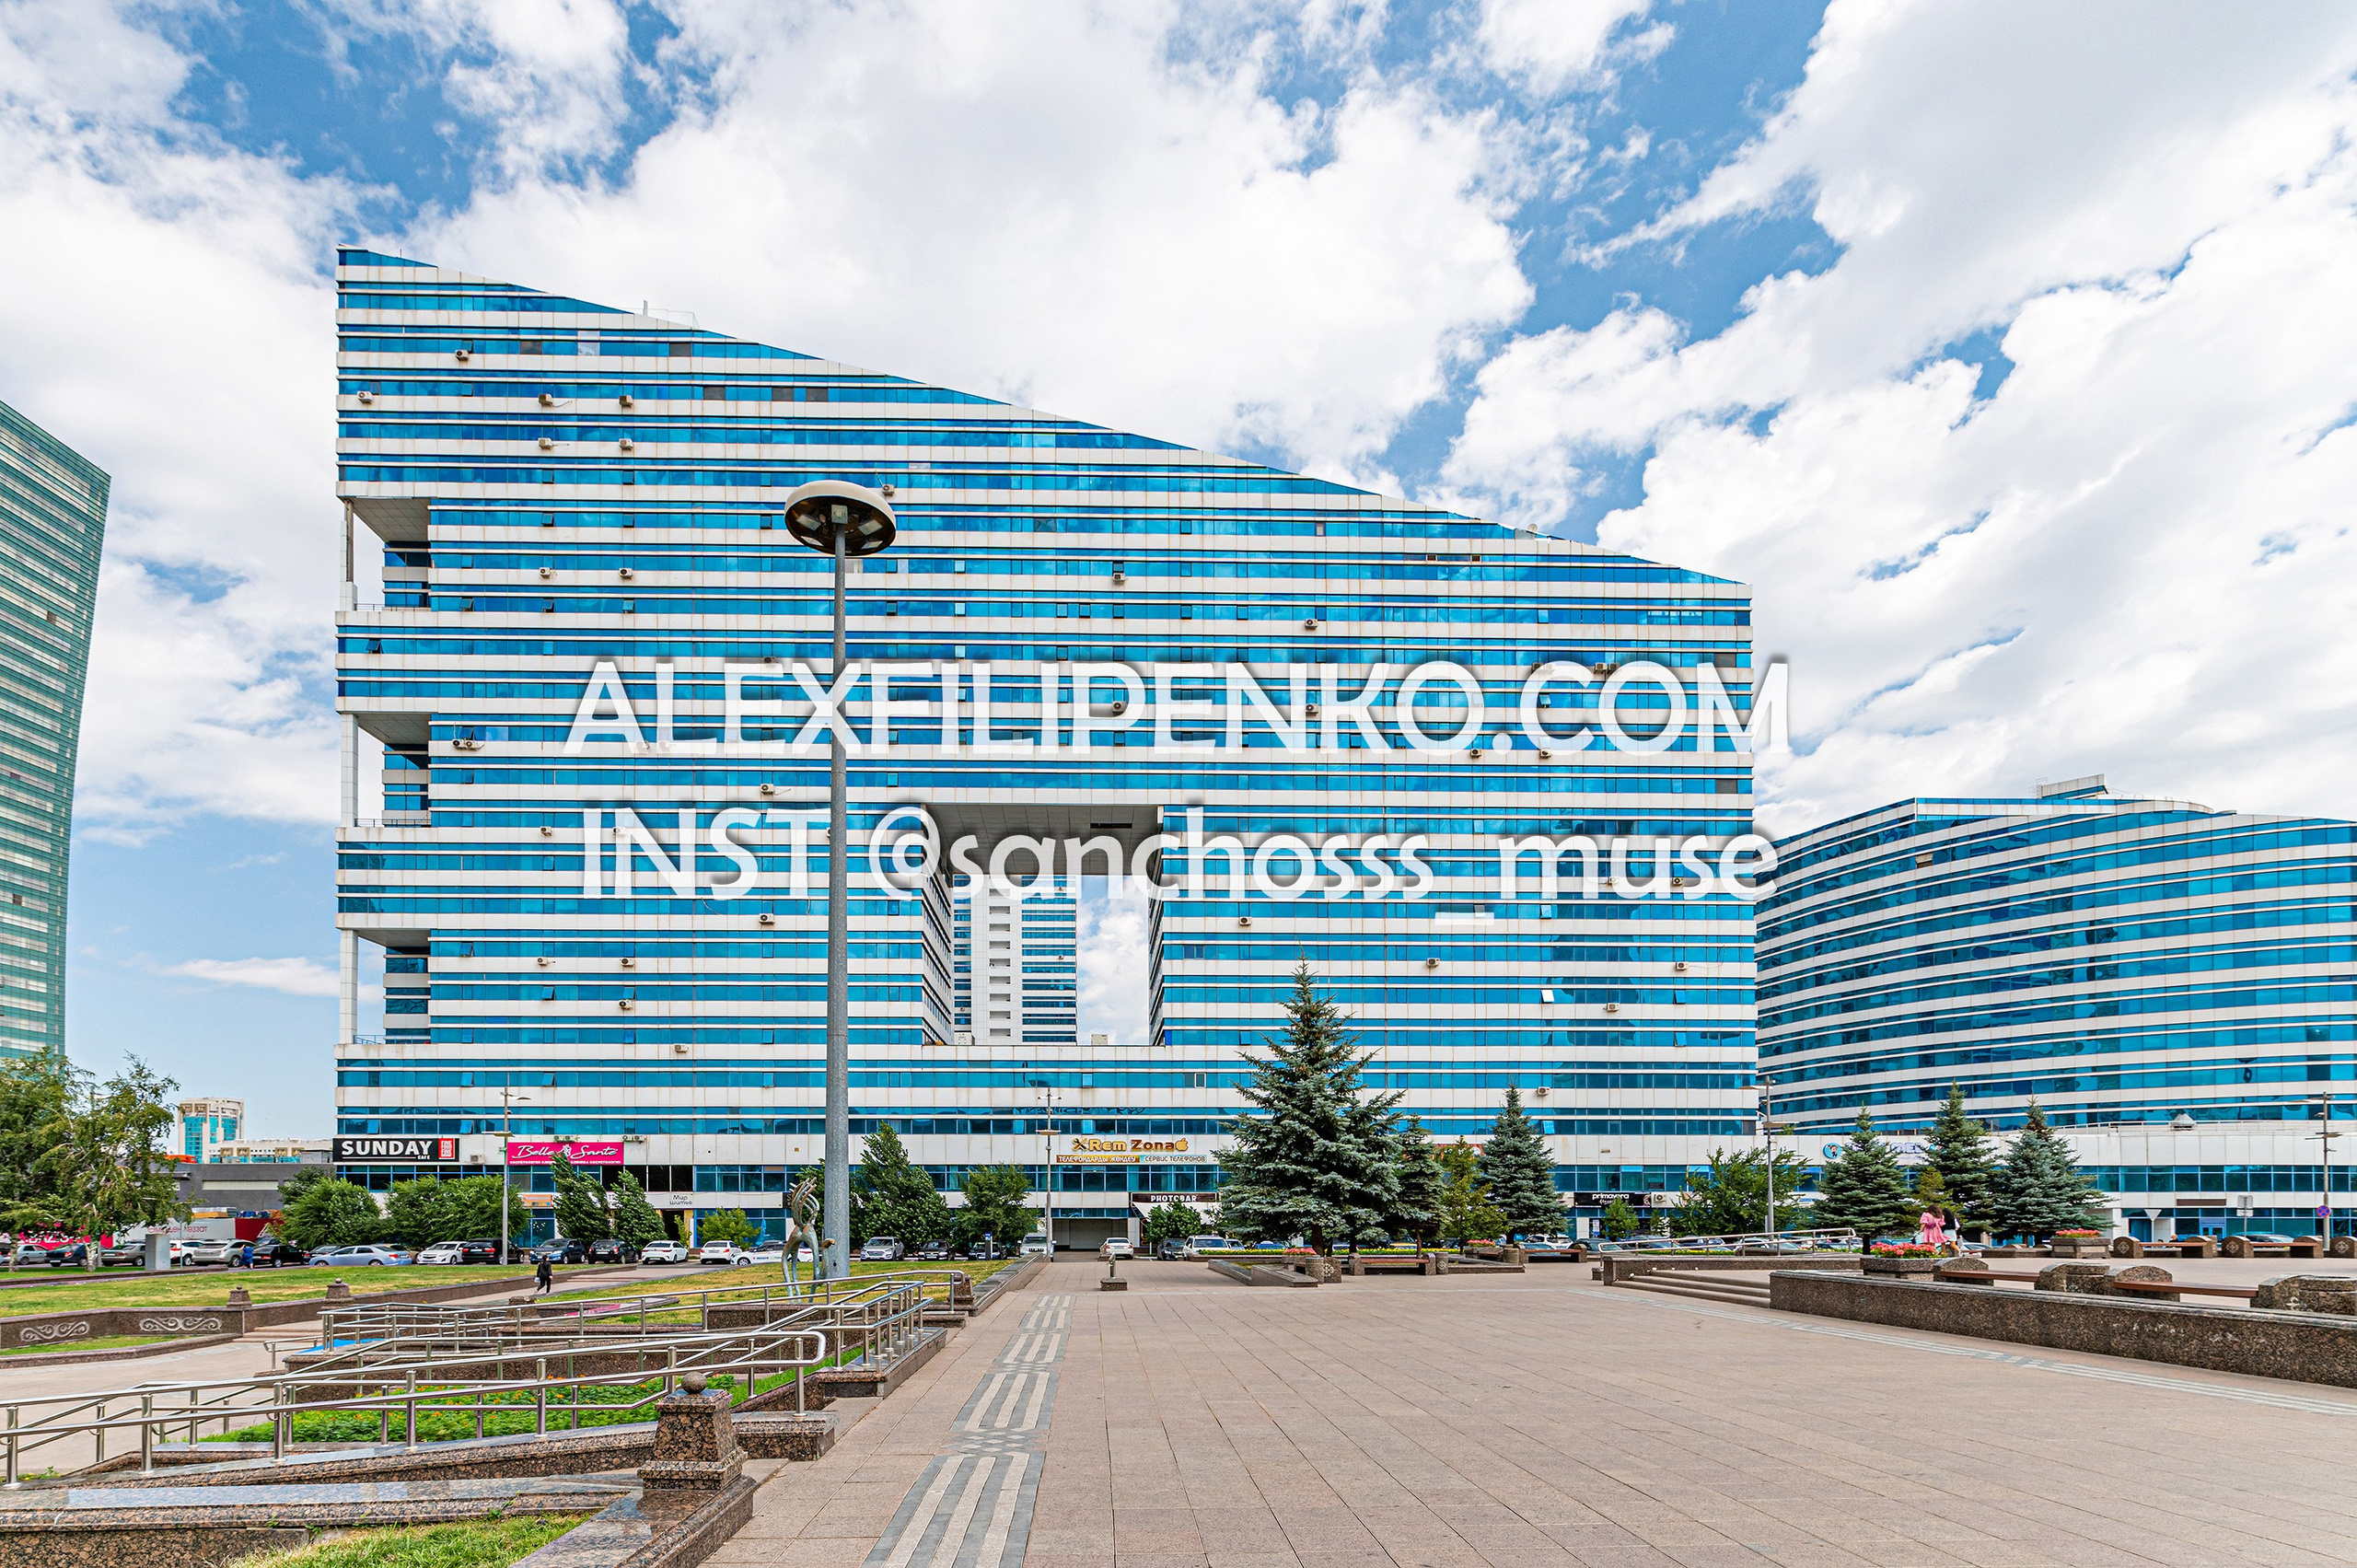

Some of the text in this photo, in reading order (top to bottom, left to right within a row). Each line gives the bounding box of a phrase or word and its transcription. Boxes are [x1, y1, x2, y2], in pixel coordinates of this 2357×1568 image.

[342, 1140, 433, 1156] SUNDAY
[1088, 1138, 1176, 1152] Rem Zona
